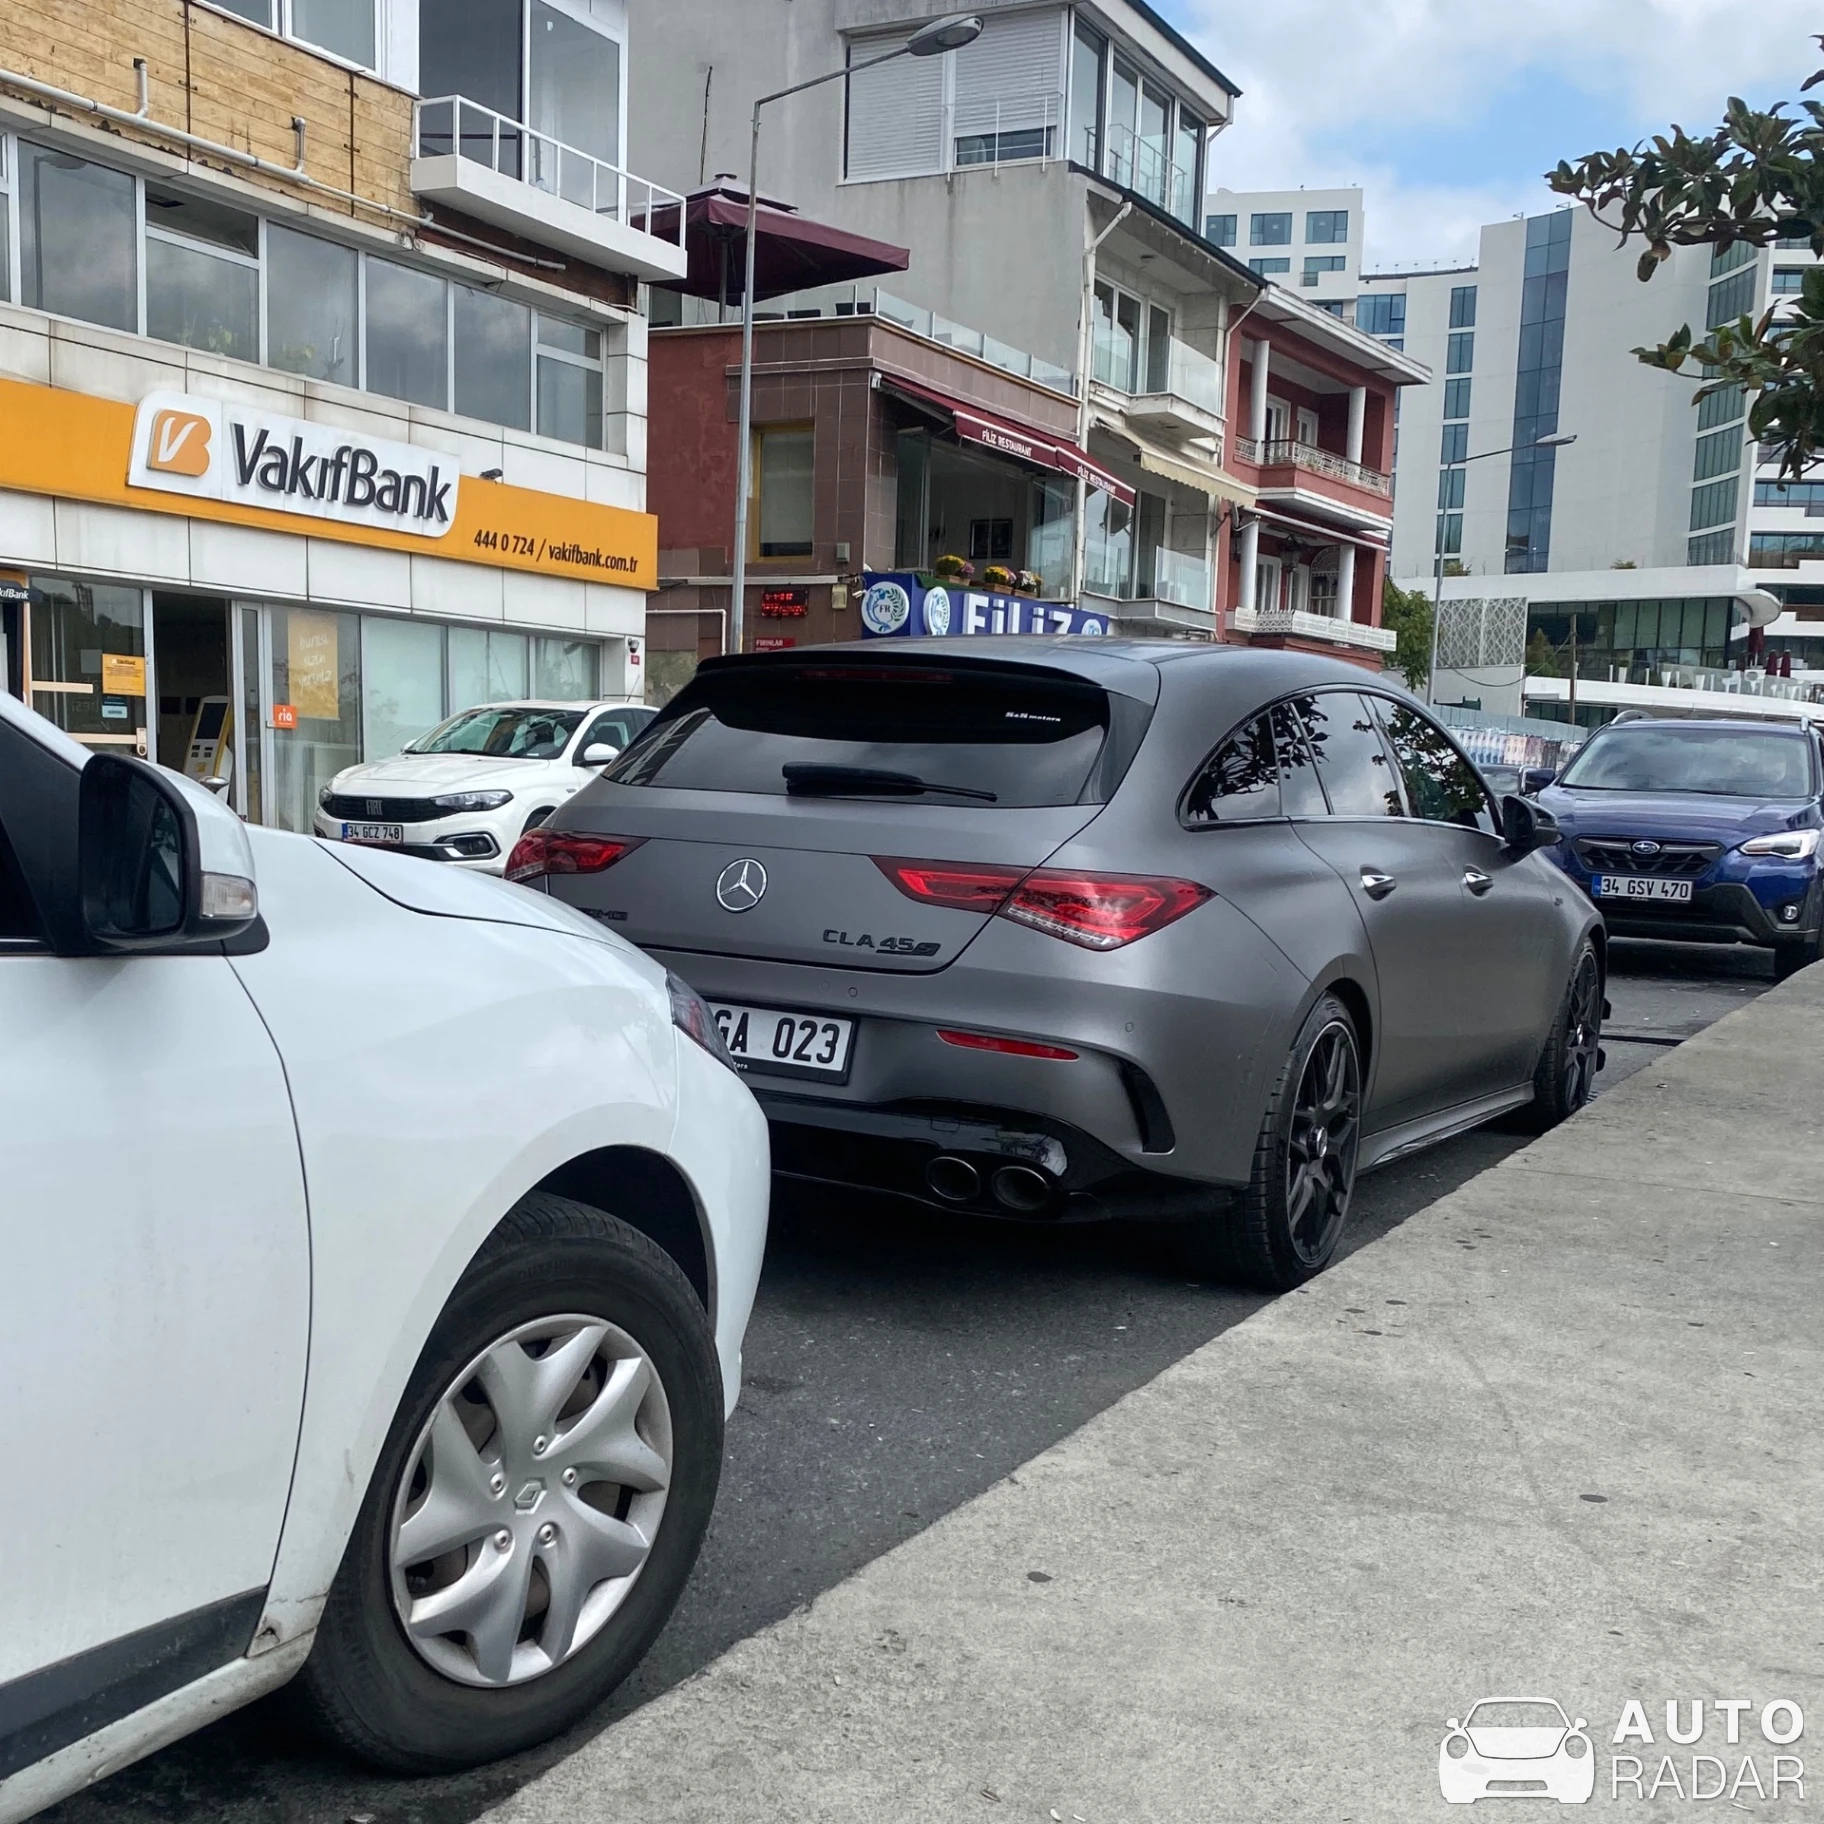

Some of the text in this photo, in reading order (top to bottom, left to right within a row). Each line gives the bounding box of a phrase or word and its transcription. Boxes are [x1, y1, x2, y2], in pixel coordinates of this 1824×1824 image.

[998, 435, 1032, 457] RESTAURANT
[229, 422, 452, 522] VakıfBank
[1089, 472, 1117, 495] RESTAURANT
[474, 529, 498, 550] 444
[501, 533, 509, 551] 0
[512, 535, 535, 556] 724
[548, 541, 639, 573] vakifbank.com.tr
[879, 602, 891, 613] FR
[278, 707, 293, 722] ria
[365, 799, 384, 816] FIAT
[348, 825, 400, 840] 34 GCZ 748
[1602, 878, 1689, 898] 34 GSV 470
[772, 1017, 840, 1064] 023
